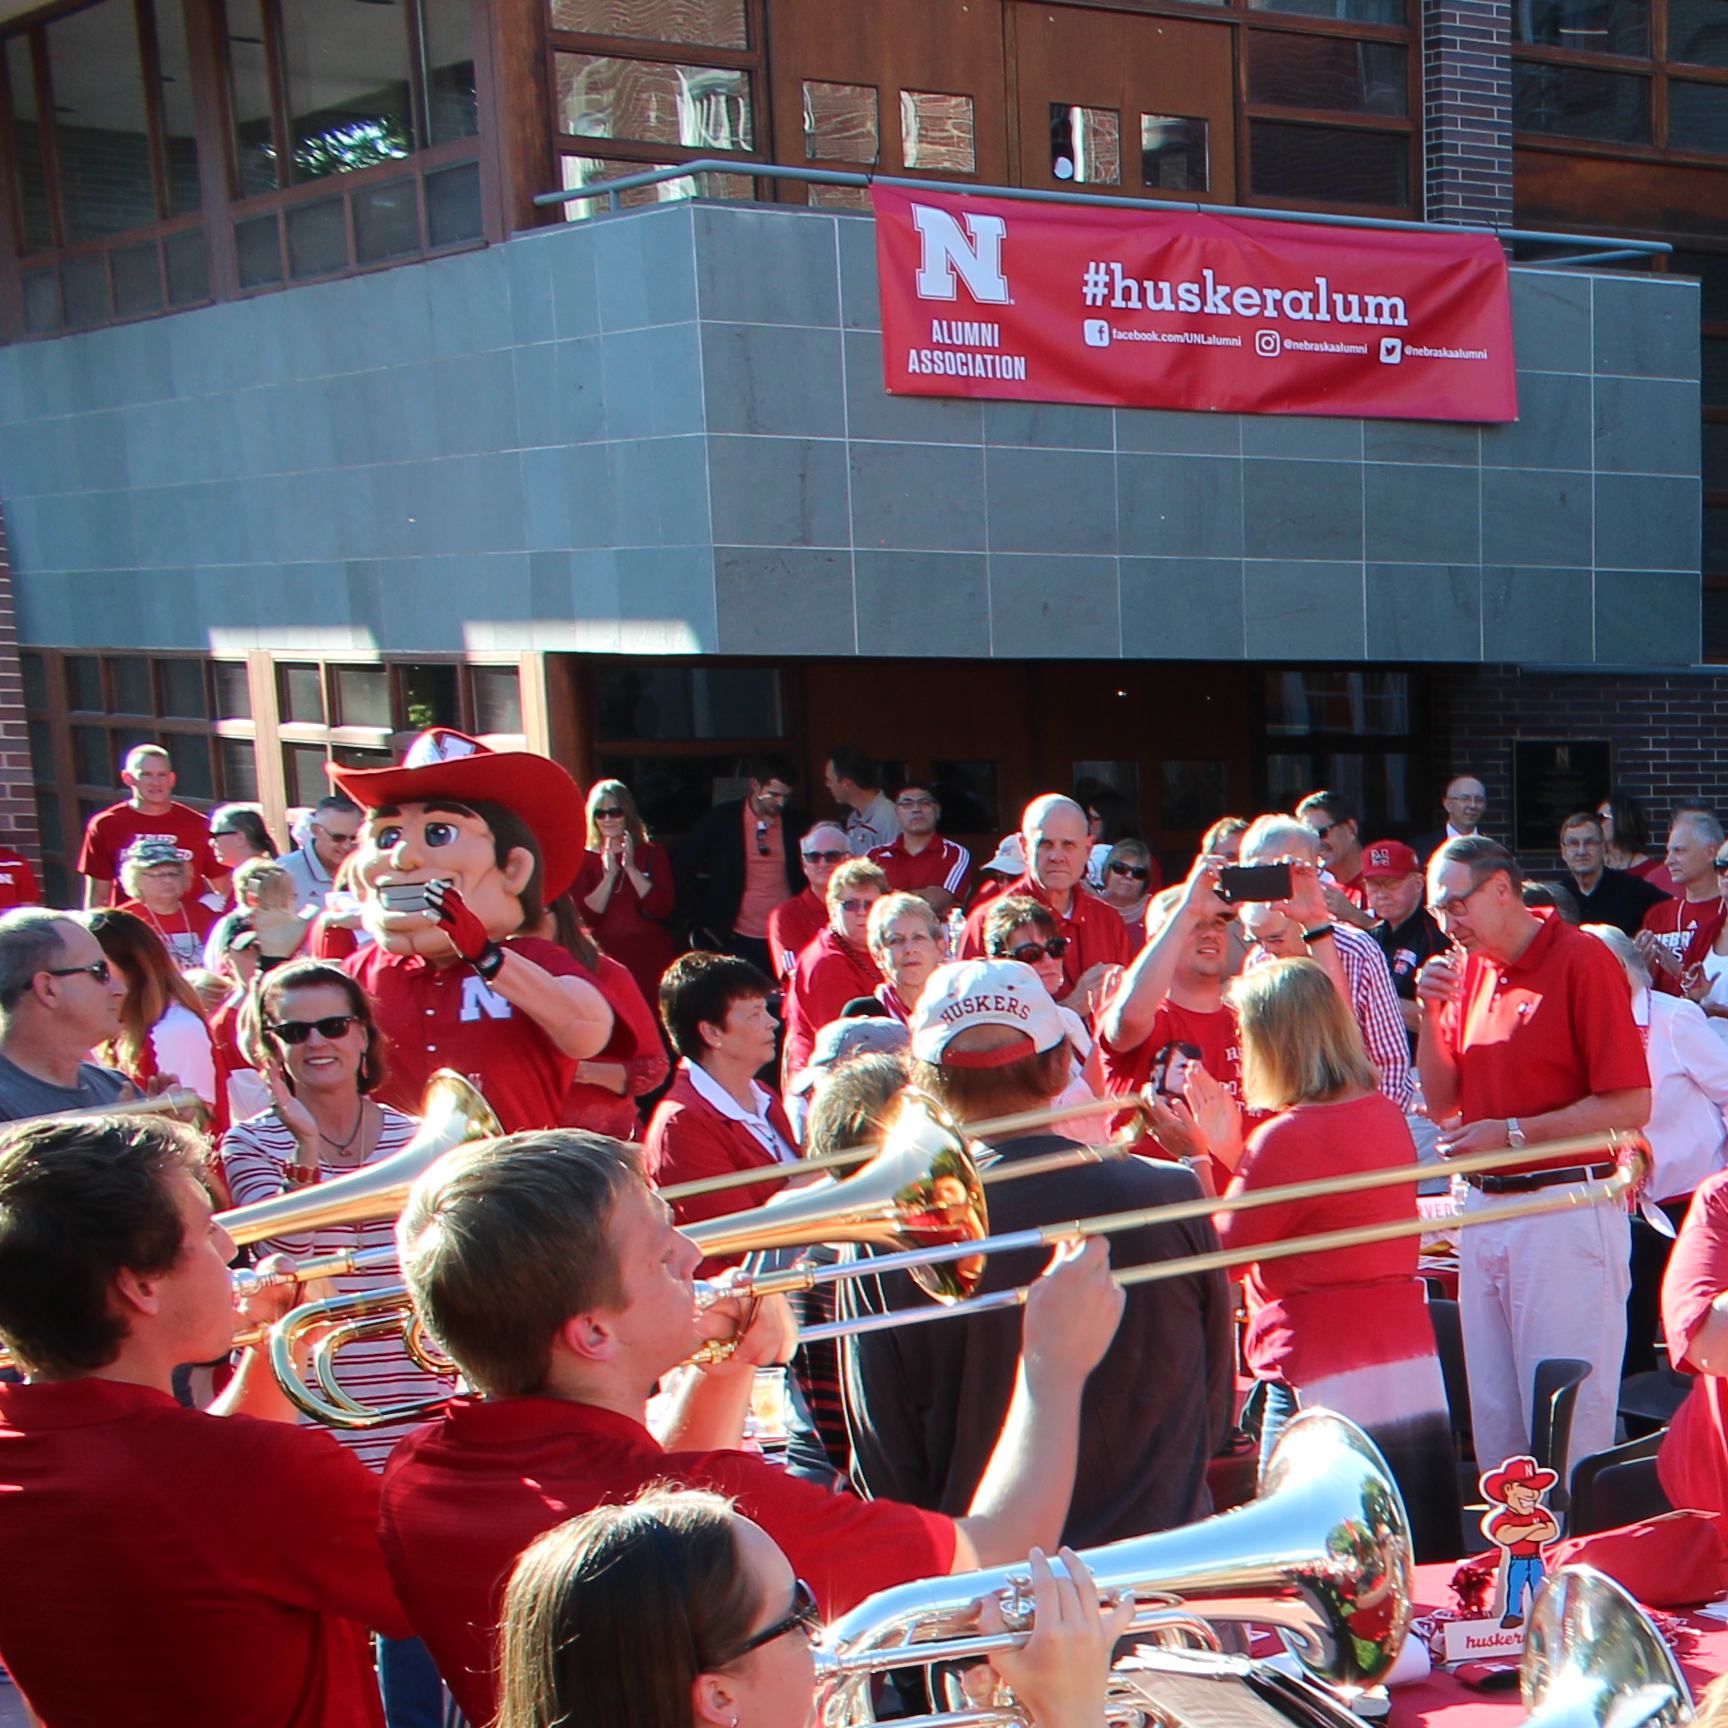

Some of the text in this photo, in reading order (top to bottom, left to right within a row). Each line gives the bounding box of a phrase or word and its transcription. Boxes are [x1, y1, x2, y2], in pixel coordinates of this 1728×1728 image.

[911, 203, 1010, 305] N
[1082, 261, 1408, 326] #huskeralum
[932, 319, 1000, 348] ALUMNI
[1112, 328, 1242, 347] facebook.com/UNLalumni
[1283, 338, 1368, 354] @nebraskaalumni
[908, 349, 1027, 381] ASSOCIATION
[1404, 344, 1487, 360] @nebraskaalumni
[460, 975, 513, 1021] N
[940, 995, 1031, 1023] HUSKERS
[1524, 1464, 1534, 1478] N
